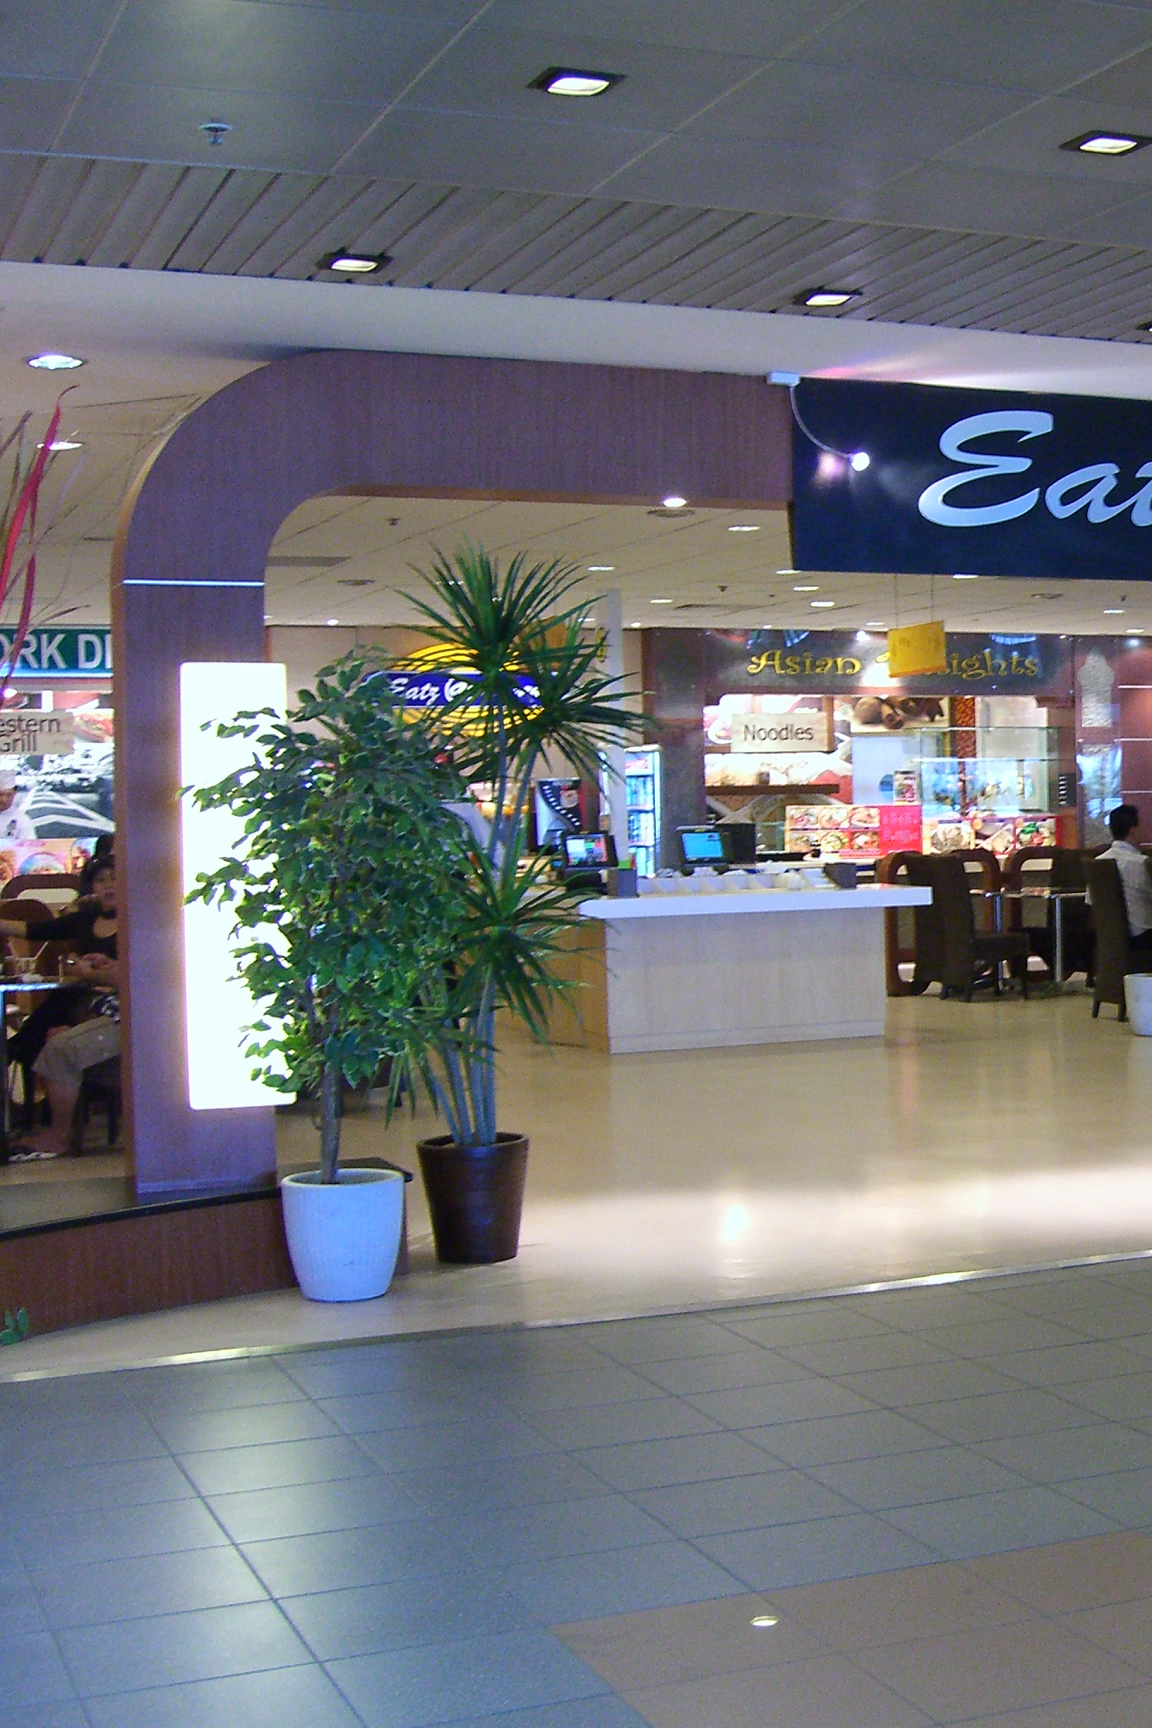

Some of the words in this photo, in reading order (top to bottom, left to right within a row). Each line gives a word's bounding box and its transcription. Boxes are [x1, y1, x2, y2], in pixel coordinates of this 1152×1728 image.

[746, 649, 862, 675] Asian
[875, 648, 1040, 680] ights
[743, 723, 814, 741] Noodles
